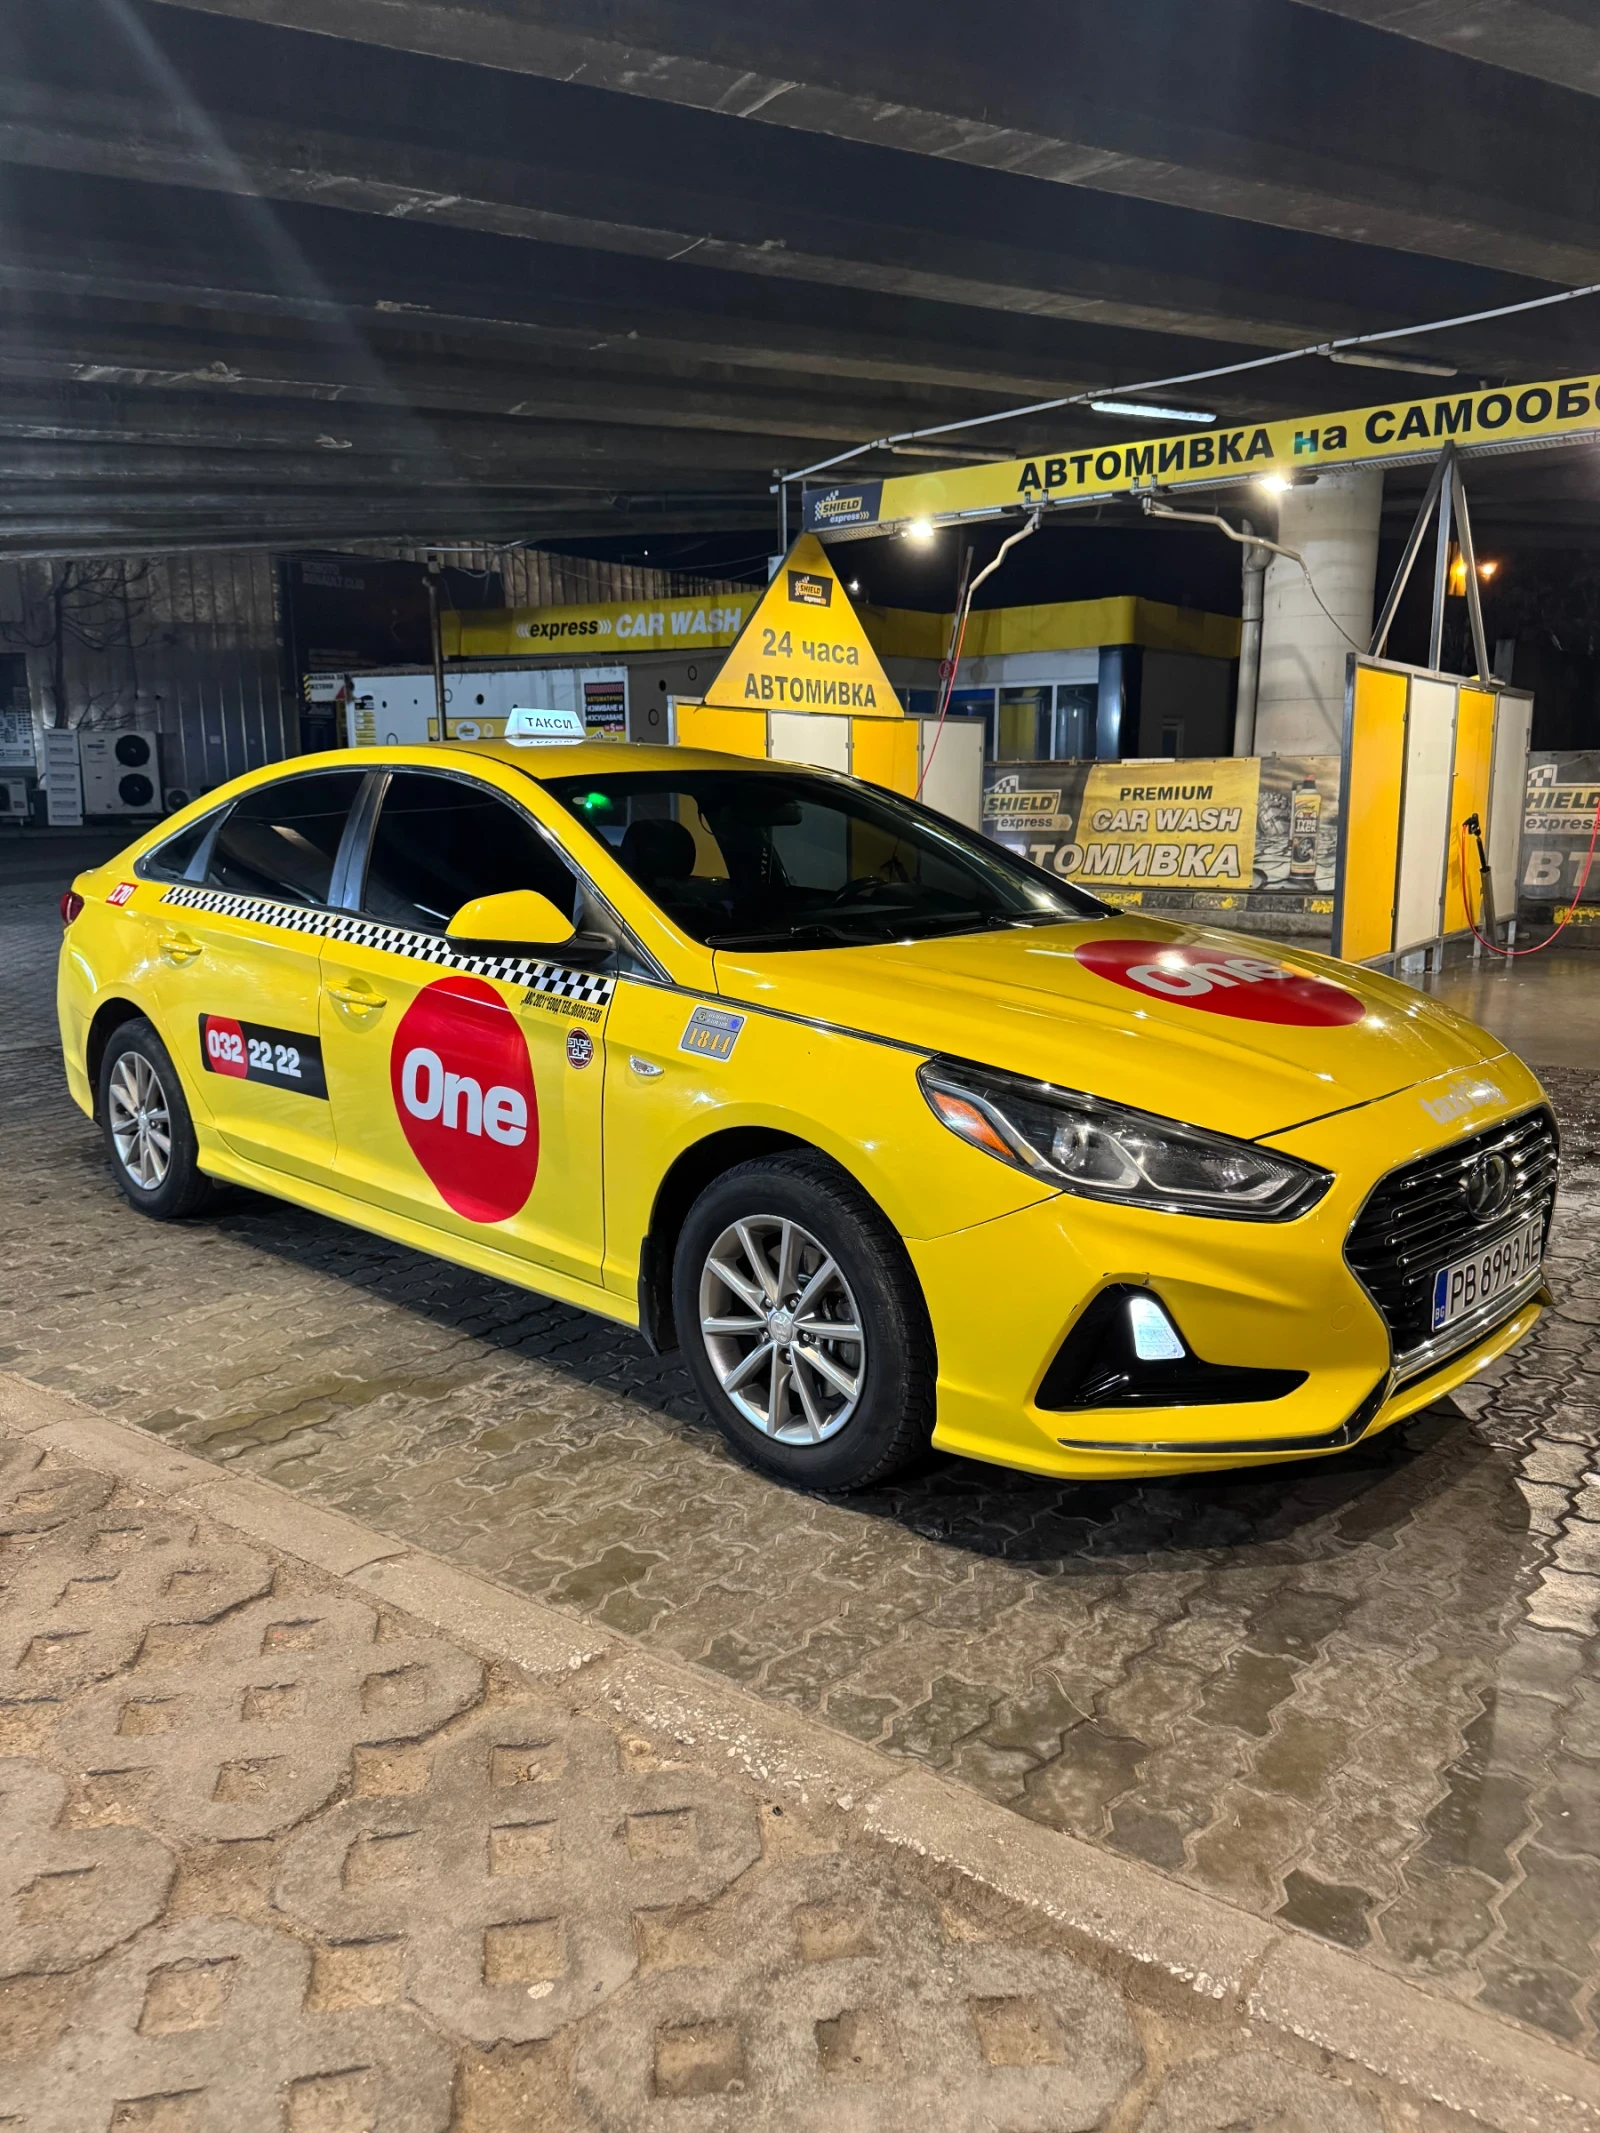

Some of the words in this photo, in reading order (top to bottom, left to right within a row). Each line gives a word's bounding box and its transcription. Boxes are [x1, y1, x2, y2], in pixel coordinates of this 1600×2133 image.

[1017, 428, 1274, 492] АВТОМИВКА
[1293, 424, 1347, 455] на
[1365, 381, 1600, 444] САМООБ
[822, 500, 859, 513] SHIELD
[830, 512, 860, 523] express
[800, 584, 820, 595] SHIELD
[530, 619, 598, 640] express
[616, 612, 664, 638] CAR
[669, 608, 742, 635] WASH
[762, 628, 793, 658] 24
[802, 640, 859, 666] часа
[744, 673, 877, 708] АВТОМИВКА
[525, 717, 574, 729] ТАКСИ
[610, 723, 616, 732] 5
[988, 796, 1053, 811] SHIELD
[1119, 786, 1213, 801] PREMIUM
[1001, 817, 1053, 829] express
[1092, 808, 1150, 832] CAR
[1155, 807, 1242, 832] WASH
[1126, 959, 1294, 996] One
[688, 1027, 731, 1053] 1844
[208, 1029, 244, 1064] 032
[248, 1038, 274, 1071] 22
[275, 1044, 302, 1078] 22
[402, 1047, 527, 1147] One
[1435, 1305, 1445, 1321] BG
[1450, 1262, 1476, 1315] PB
[1480, 1236, 1520, 1297] 8993
[1521, 1220, 1541, 1272] AE
